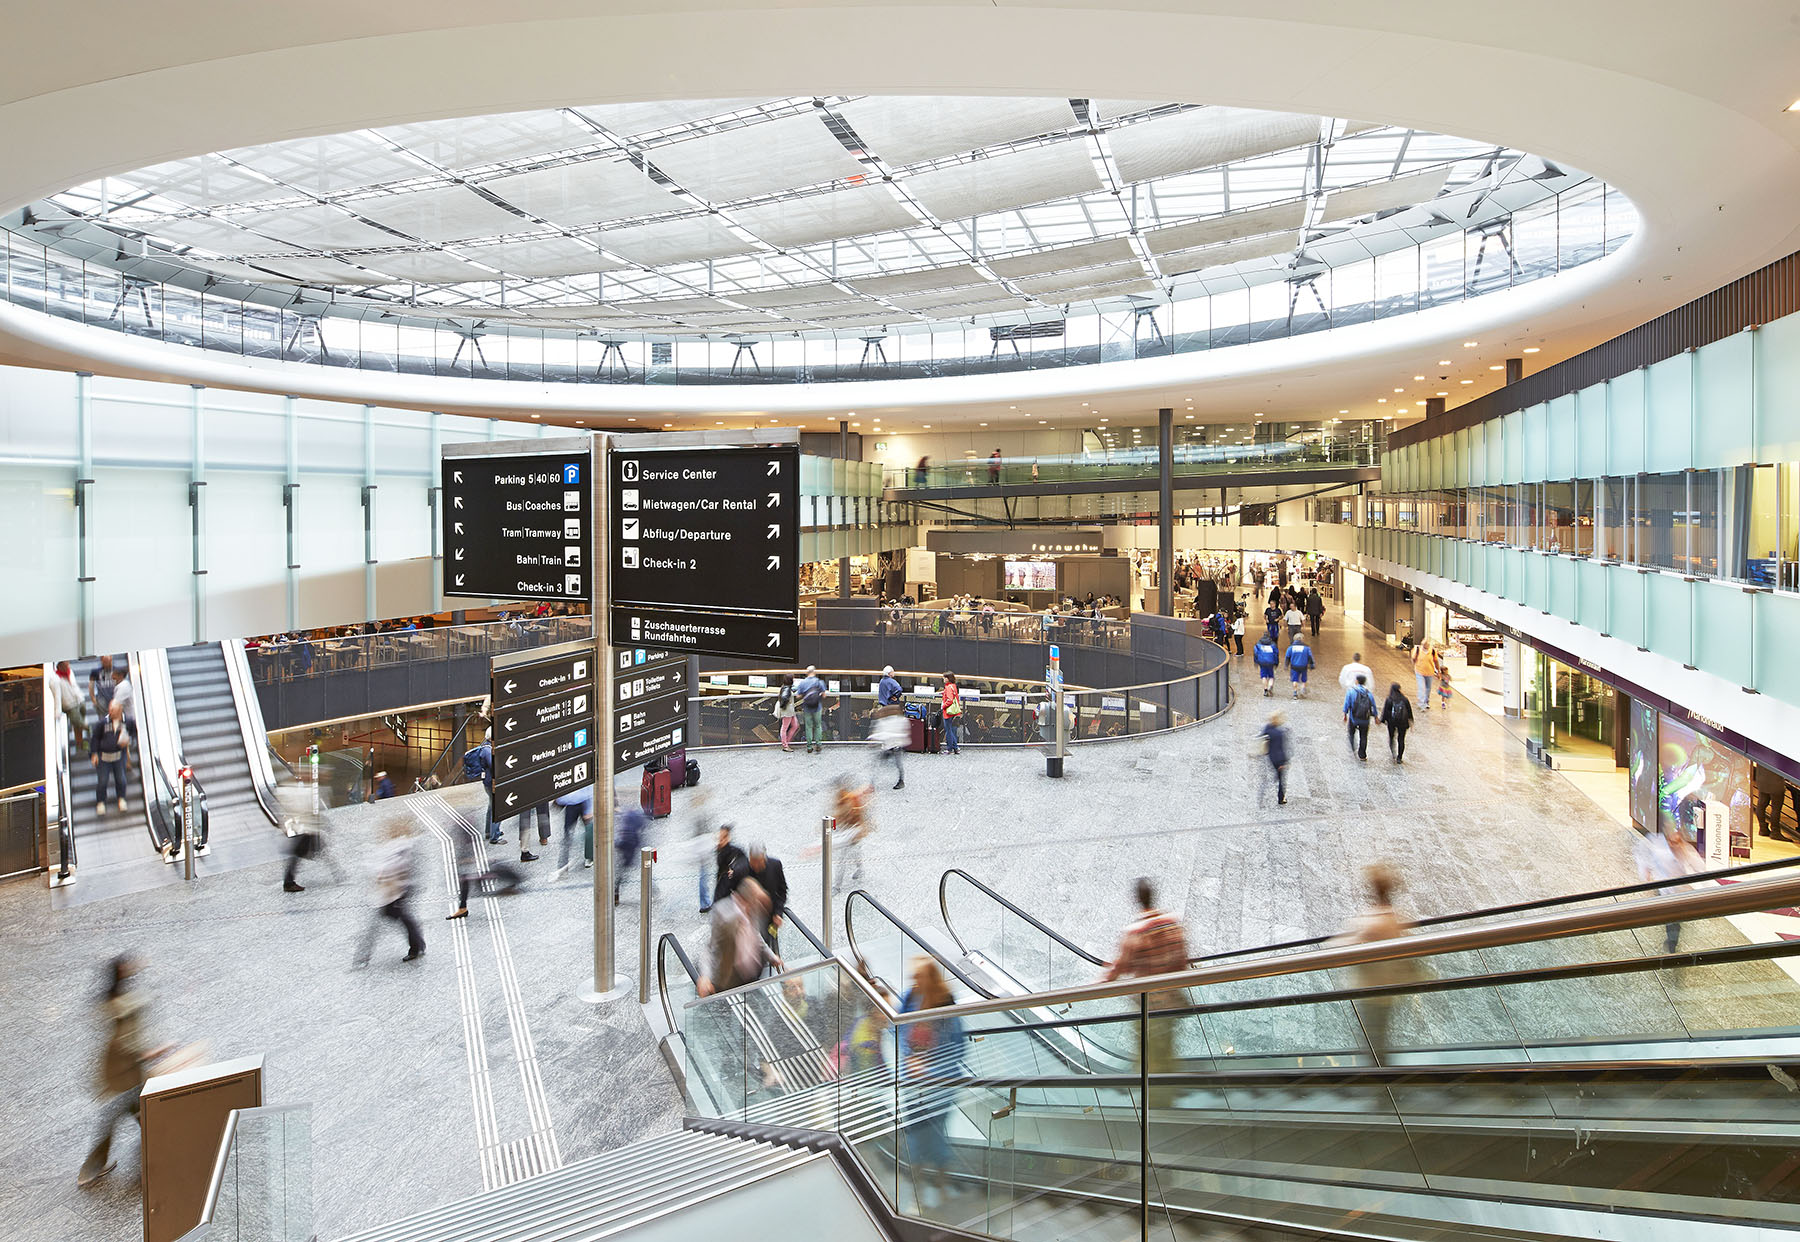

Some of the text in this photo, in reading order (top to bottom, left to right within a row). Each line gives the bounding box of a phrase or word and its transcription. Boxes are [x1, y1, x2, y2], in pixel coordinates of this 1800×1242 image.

[494, 475, 526, 486] Parking
[642, 469, 679, 480] Service
[682, 469, 716, 479] Center
[642, 499, 757, 511] Mietwagen/Car Rental
[642, 528, 732, 541] Abflug/Departure
[643, 557, 697, 570] Check-in 2
[517, 581, 562, 593] Check-in 3
[644, 620, 726, 636] Zuschauerterrasse
[644, 631, 697, 644] Rundfahrten
[539, 675, 566, 687] Check-in
[535, 703, 560, 716] Ankunft
[540, 711, 560, 723] Arrival
[531, 749, 556, 762] Parking
[552, 769, 572, 782] Polizei
[554, 778, 572, 790] Police
